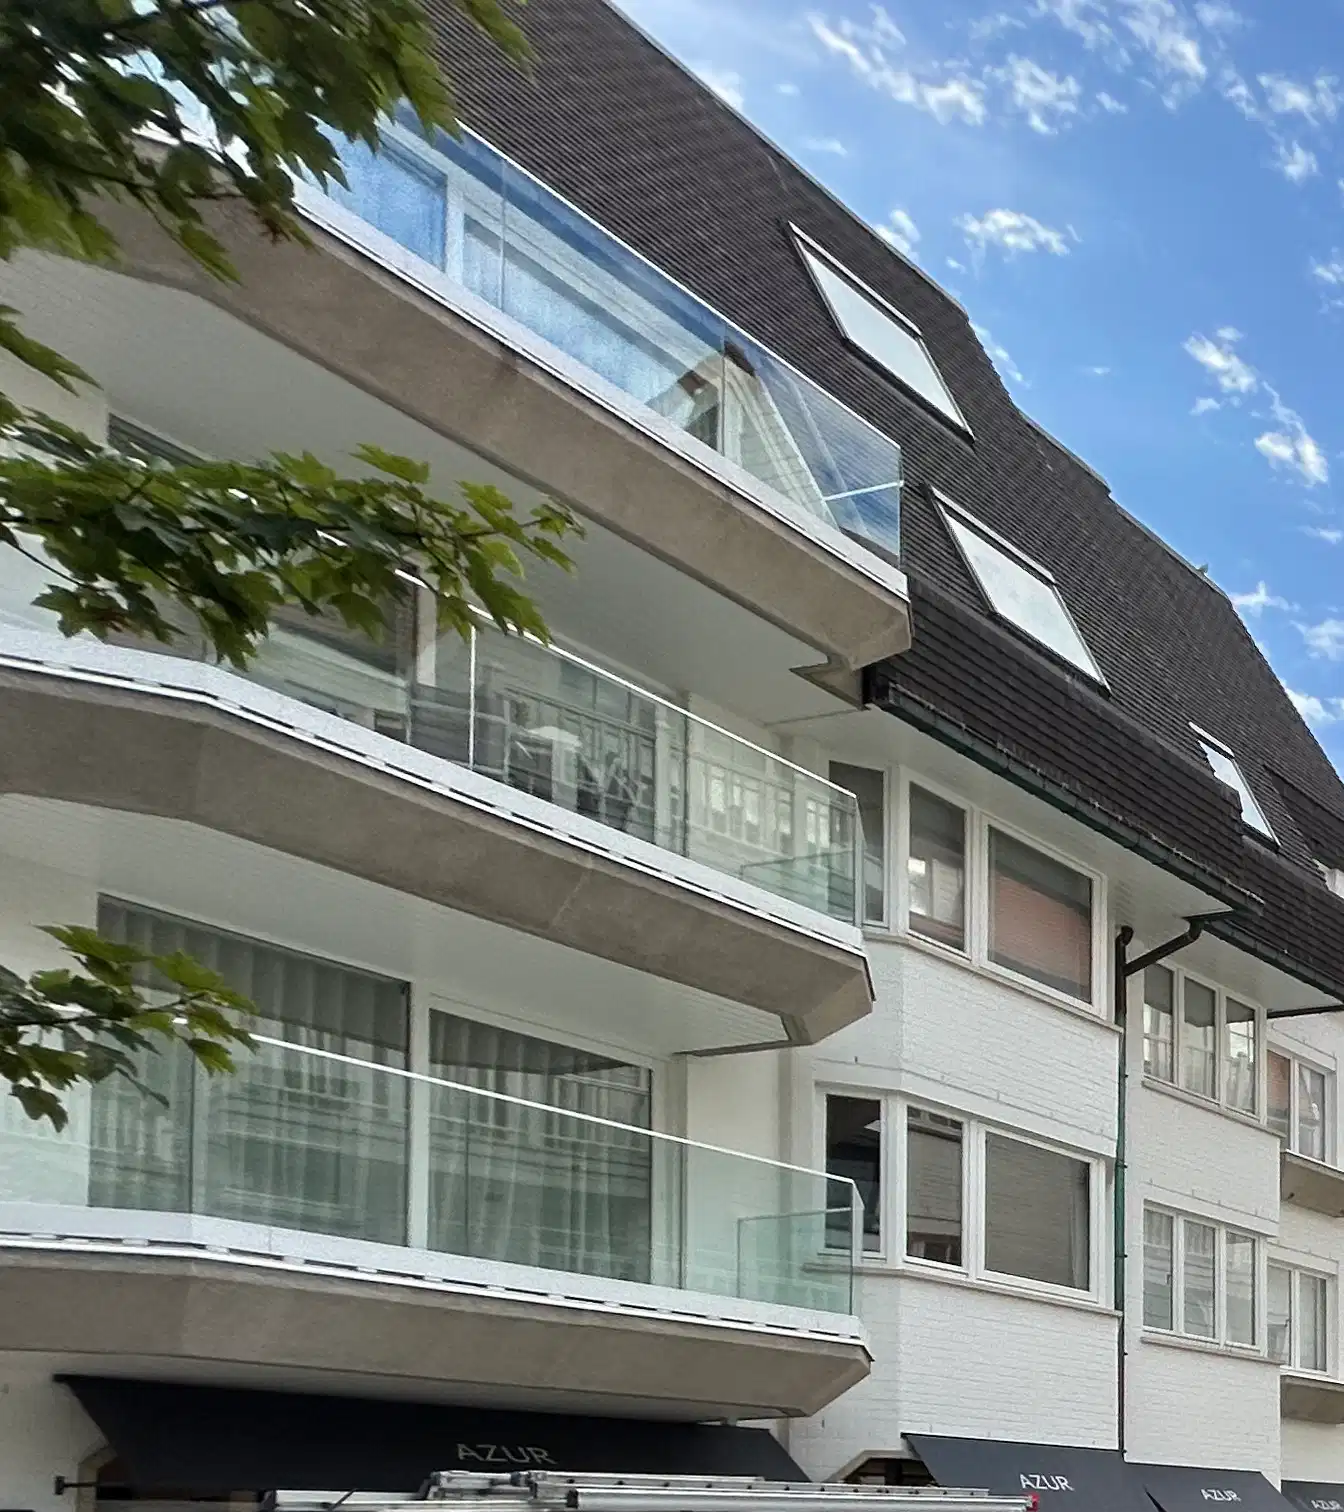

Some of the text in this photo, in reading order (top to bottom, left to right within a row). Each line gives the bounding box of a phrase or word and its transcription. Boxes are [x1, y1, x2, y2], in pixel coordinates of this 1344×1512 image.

[457, 1443, 558, 1465] AZUR
[1019, 1473, 1074, 1491] AZUR
[1200, 1488, 1240, 1502] AZUR
[1311, 1499, 1343, 1511] AZUR
